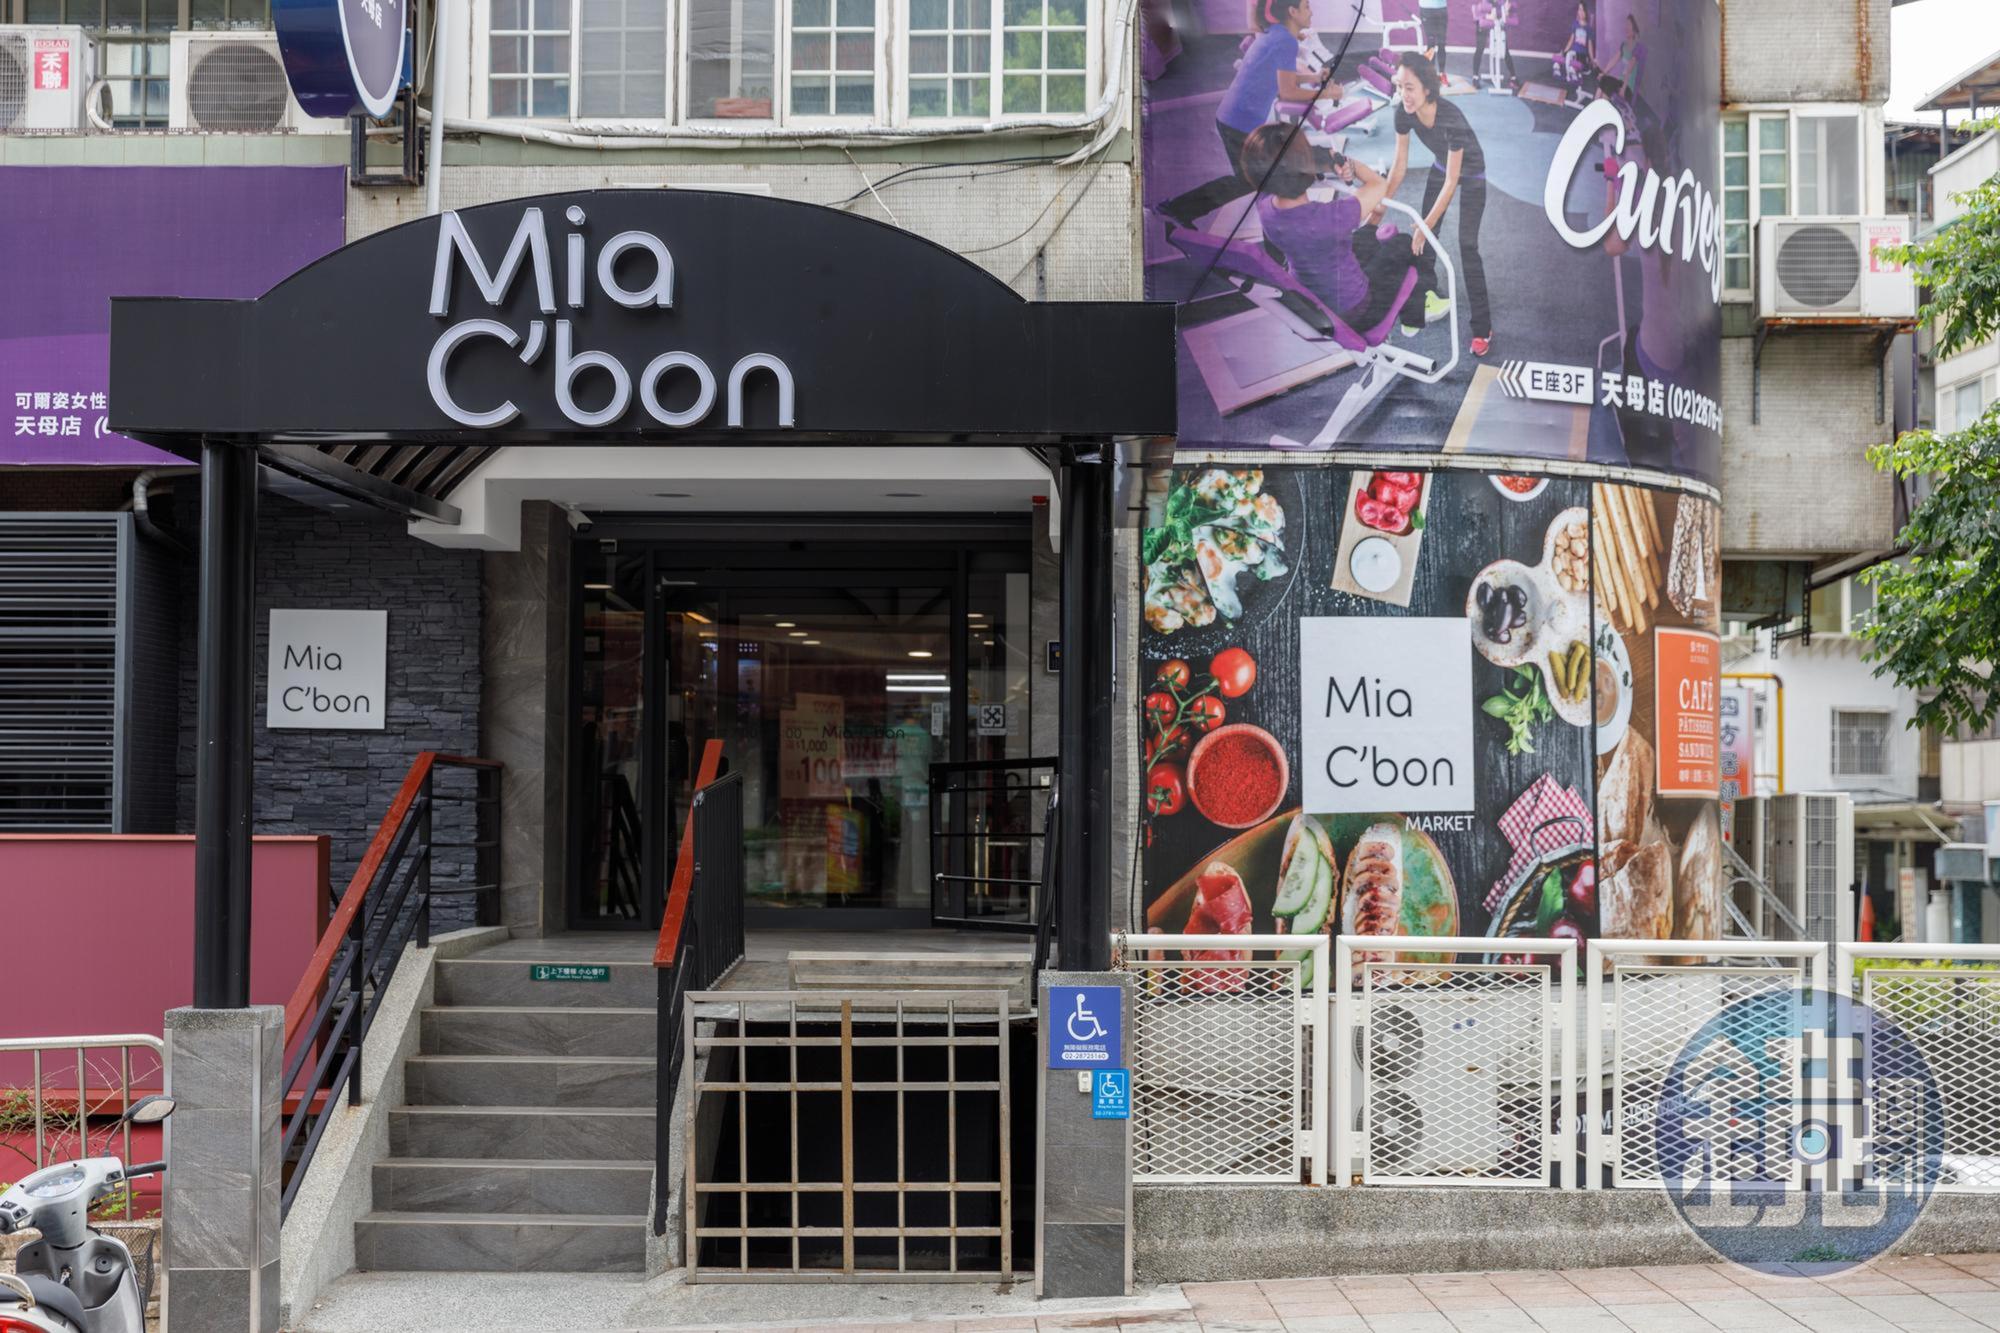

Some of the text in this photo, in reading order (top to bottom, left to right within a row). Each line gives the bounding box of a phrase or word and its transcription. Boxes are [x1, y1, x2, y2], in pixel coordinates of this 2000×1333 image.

[41, 52, 62, 88] 禾聯
[1544, 98, 1721, 304] Curves
[429, 205, 674, 317] Mia
[427, 319, 796, 429] C'bon
[1530, 369, 1585, 395] E座3F
[15, 391, 107, 410] 可爾姿女性
[1601, 371, 1665, 417] 天母店
[15, 415, 82, 436] 天母店
[283, 644, 342, 671] Mia
[282, 686, 370, 713] C'bon
[1325, 676, 1413, 718] Mia
[1679, 676, 1714, 711] CAFÉ
[1326, 745, 1454, 788] C'bon
[1405, 815, 1475, 832] MARKET
